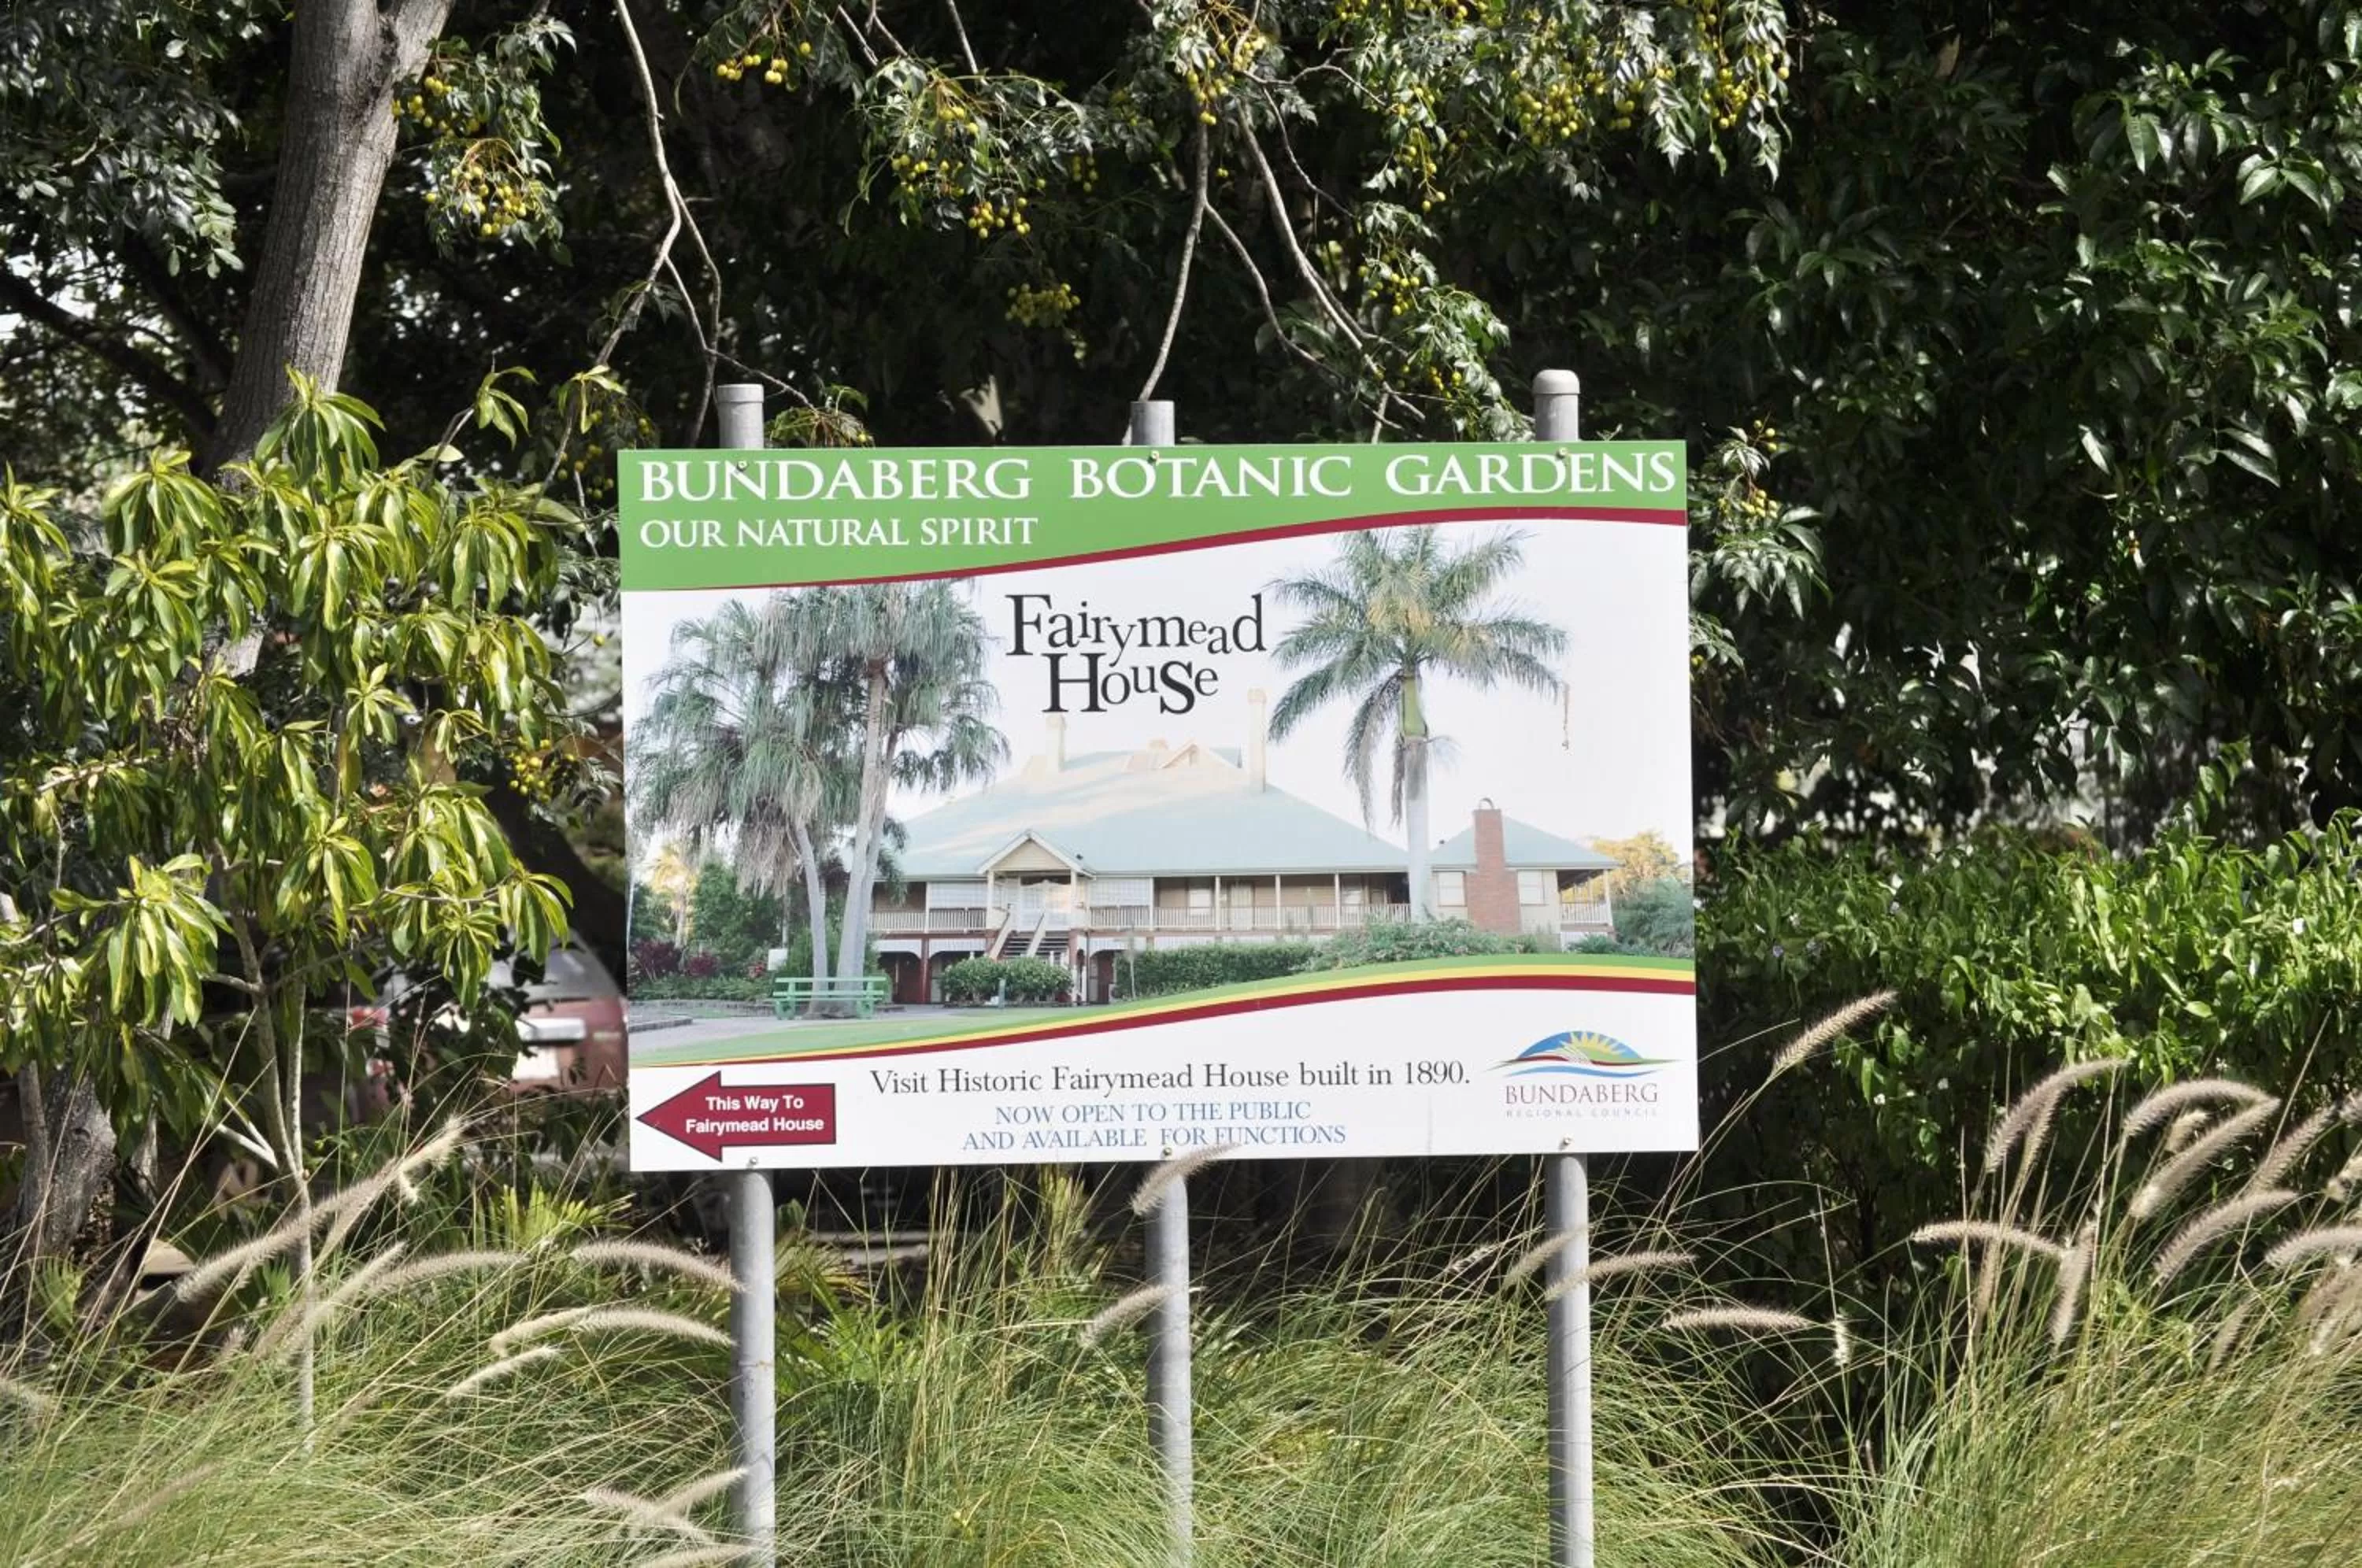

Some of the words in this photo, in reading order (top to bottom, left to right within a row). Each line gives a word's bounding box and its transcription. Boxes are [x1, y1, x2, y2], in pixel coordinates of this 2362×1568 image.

[640, 458, 1031, 502] BUNDABERG
[1070, 457, 1351, 498] BOTANIC
[1385, 451, 1675, 496] GARDENS
[640, 519, 727, 549] OUR
[737, 517, 909, 546] NATURAL
[920, 516, 1038, 545] SPIRIT
[1005, 593, 1267, 668] Fairymead
[870, 1069, 929, 1094] Visit
[938, 1068, 1042, 1093] Historic
[1052, 1064, 1193, 1097] Fairymead
[1203, 1063, 1290, 1087] House
[1299, 1061, 1359, 1086] built
[1368, 1063, 1392, 1085] in
[1405, 1060, 1471, 1085] 1890.
[706, 1097, 740, 1111] This
[745, 1096, 778, 1111] Way
[783, 1095, 804, 1108] To
[1505, 1083, 1658, 1104] BUNDABERG
[995, 1106, 1055, 1125] NOW
[1061, 1104, 1124, 1123] OPEN
[1131, 1104, 1167, 1122] TO
[1173, 1103, 1222, 1121] THE
[1229, 1101, 1311, 1120] PUBLIC
[687, 1119, 769, 1136] Fairymead
[773, 1117, 824, 1131] House
[963, 1132, 1015, 1151] AND
[1022, 1129, 1147, 1149] AVAILABLE
[1160, 1126, 1208, 1146] FOR
[1215, 1125, 1346, 1145] FUNCTIONS
